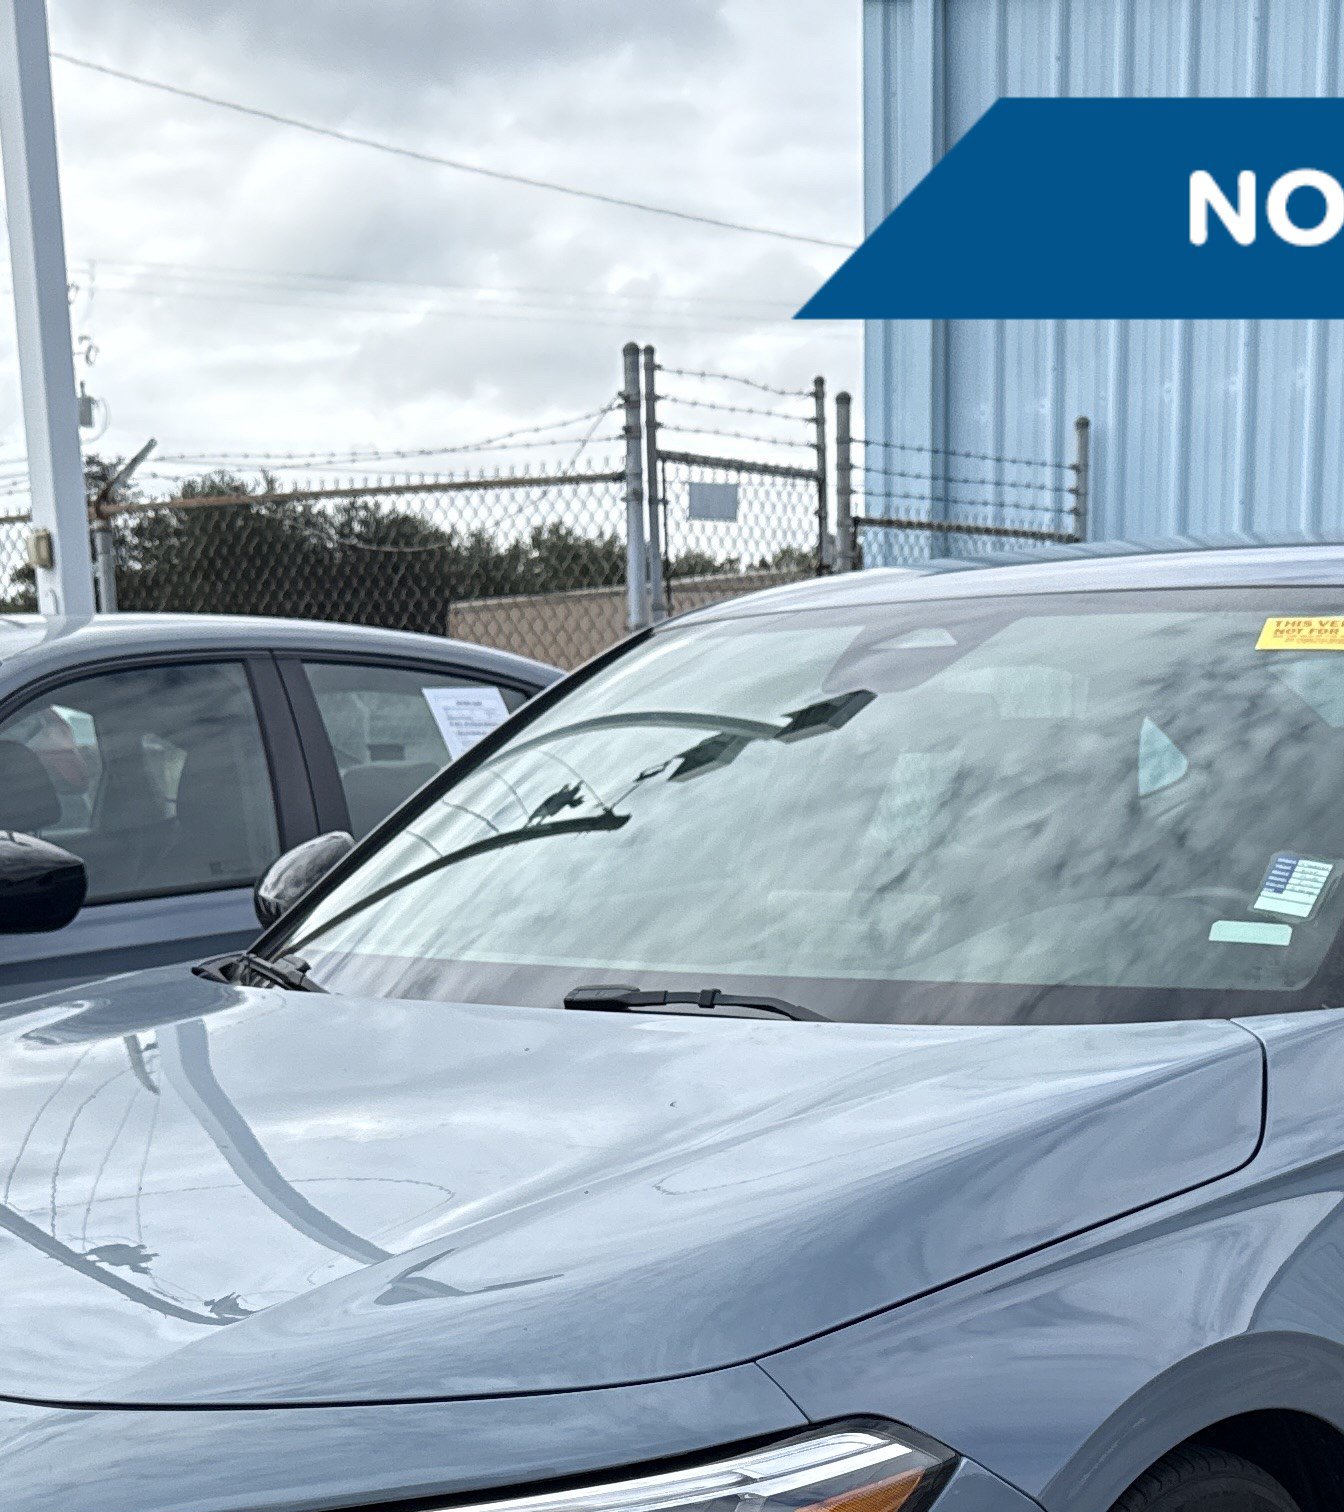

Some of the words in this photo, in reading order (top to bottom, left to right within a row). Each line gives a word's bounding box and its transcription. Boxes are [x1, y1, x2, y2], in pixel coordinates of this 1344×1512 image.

[1275, 620, 1313, 628] THIS
[1273, 628, 1304, 636] NOT
[1308, 628, 1340, 636] FOR
